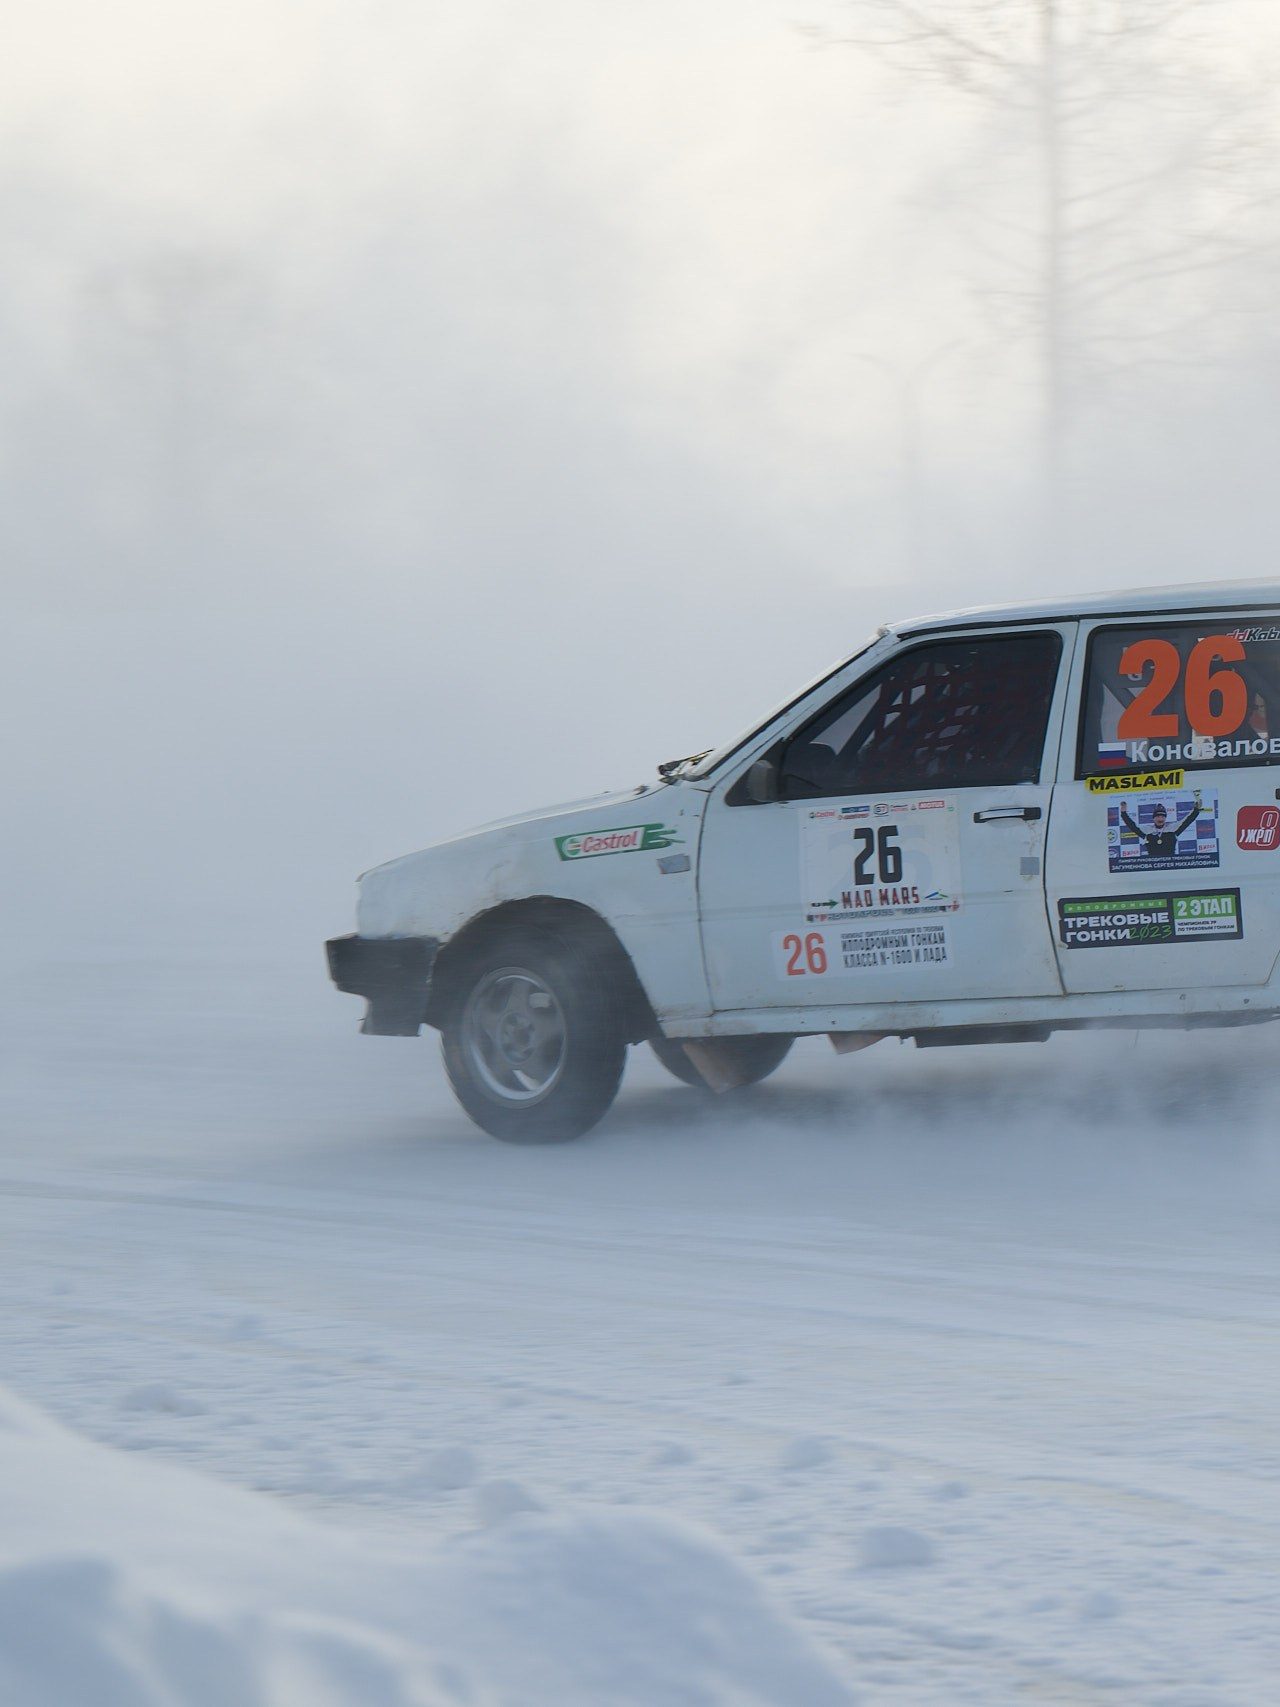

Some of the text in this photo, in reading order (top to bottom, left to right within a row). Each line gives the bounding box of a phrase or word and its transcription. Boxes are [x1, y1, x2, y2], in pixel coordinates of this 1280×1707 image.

[1117, 634, 1248, 740] 26
[1089, 770, 1181, 791] MASLAMI
[582, 831, 638, 853] Castrol
[853, 825, 903, 885] 26
[1112, 859, 1219, 871] ЗАГУМЕННОВА СЕРГЕЯ МИХАЙЛОВИЧА
[841, 886, 920, 909] MAD MARS
[1177, 898, 1233, 916] 2 ЭТАП
[1064, 912, 1170, 928] ТРЕКОВЫЕ
[841, 932, 946, 952] ИППОДРОМНЫМ ГОНКАМ
[1066, 924, 1172, 943] ГОНКИ 2023
[783, 932, 828, 976] 26
[843, 946, 948, 969] КЛАССА N-1600 И ЛАДА
